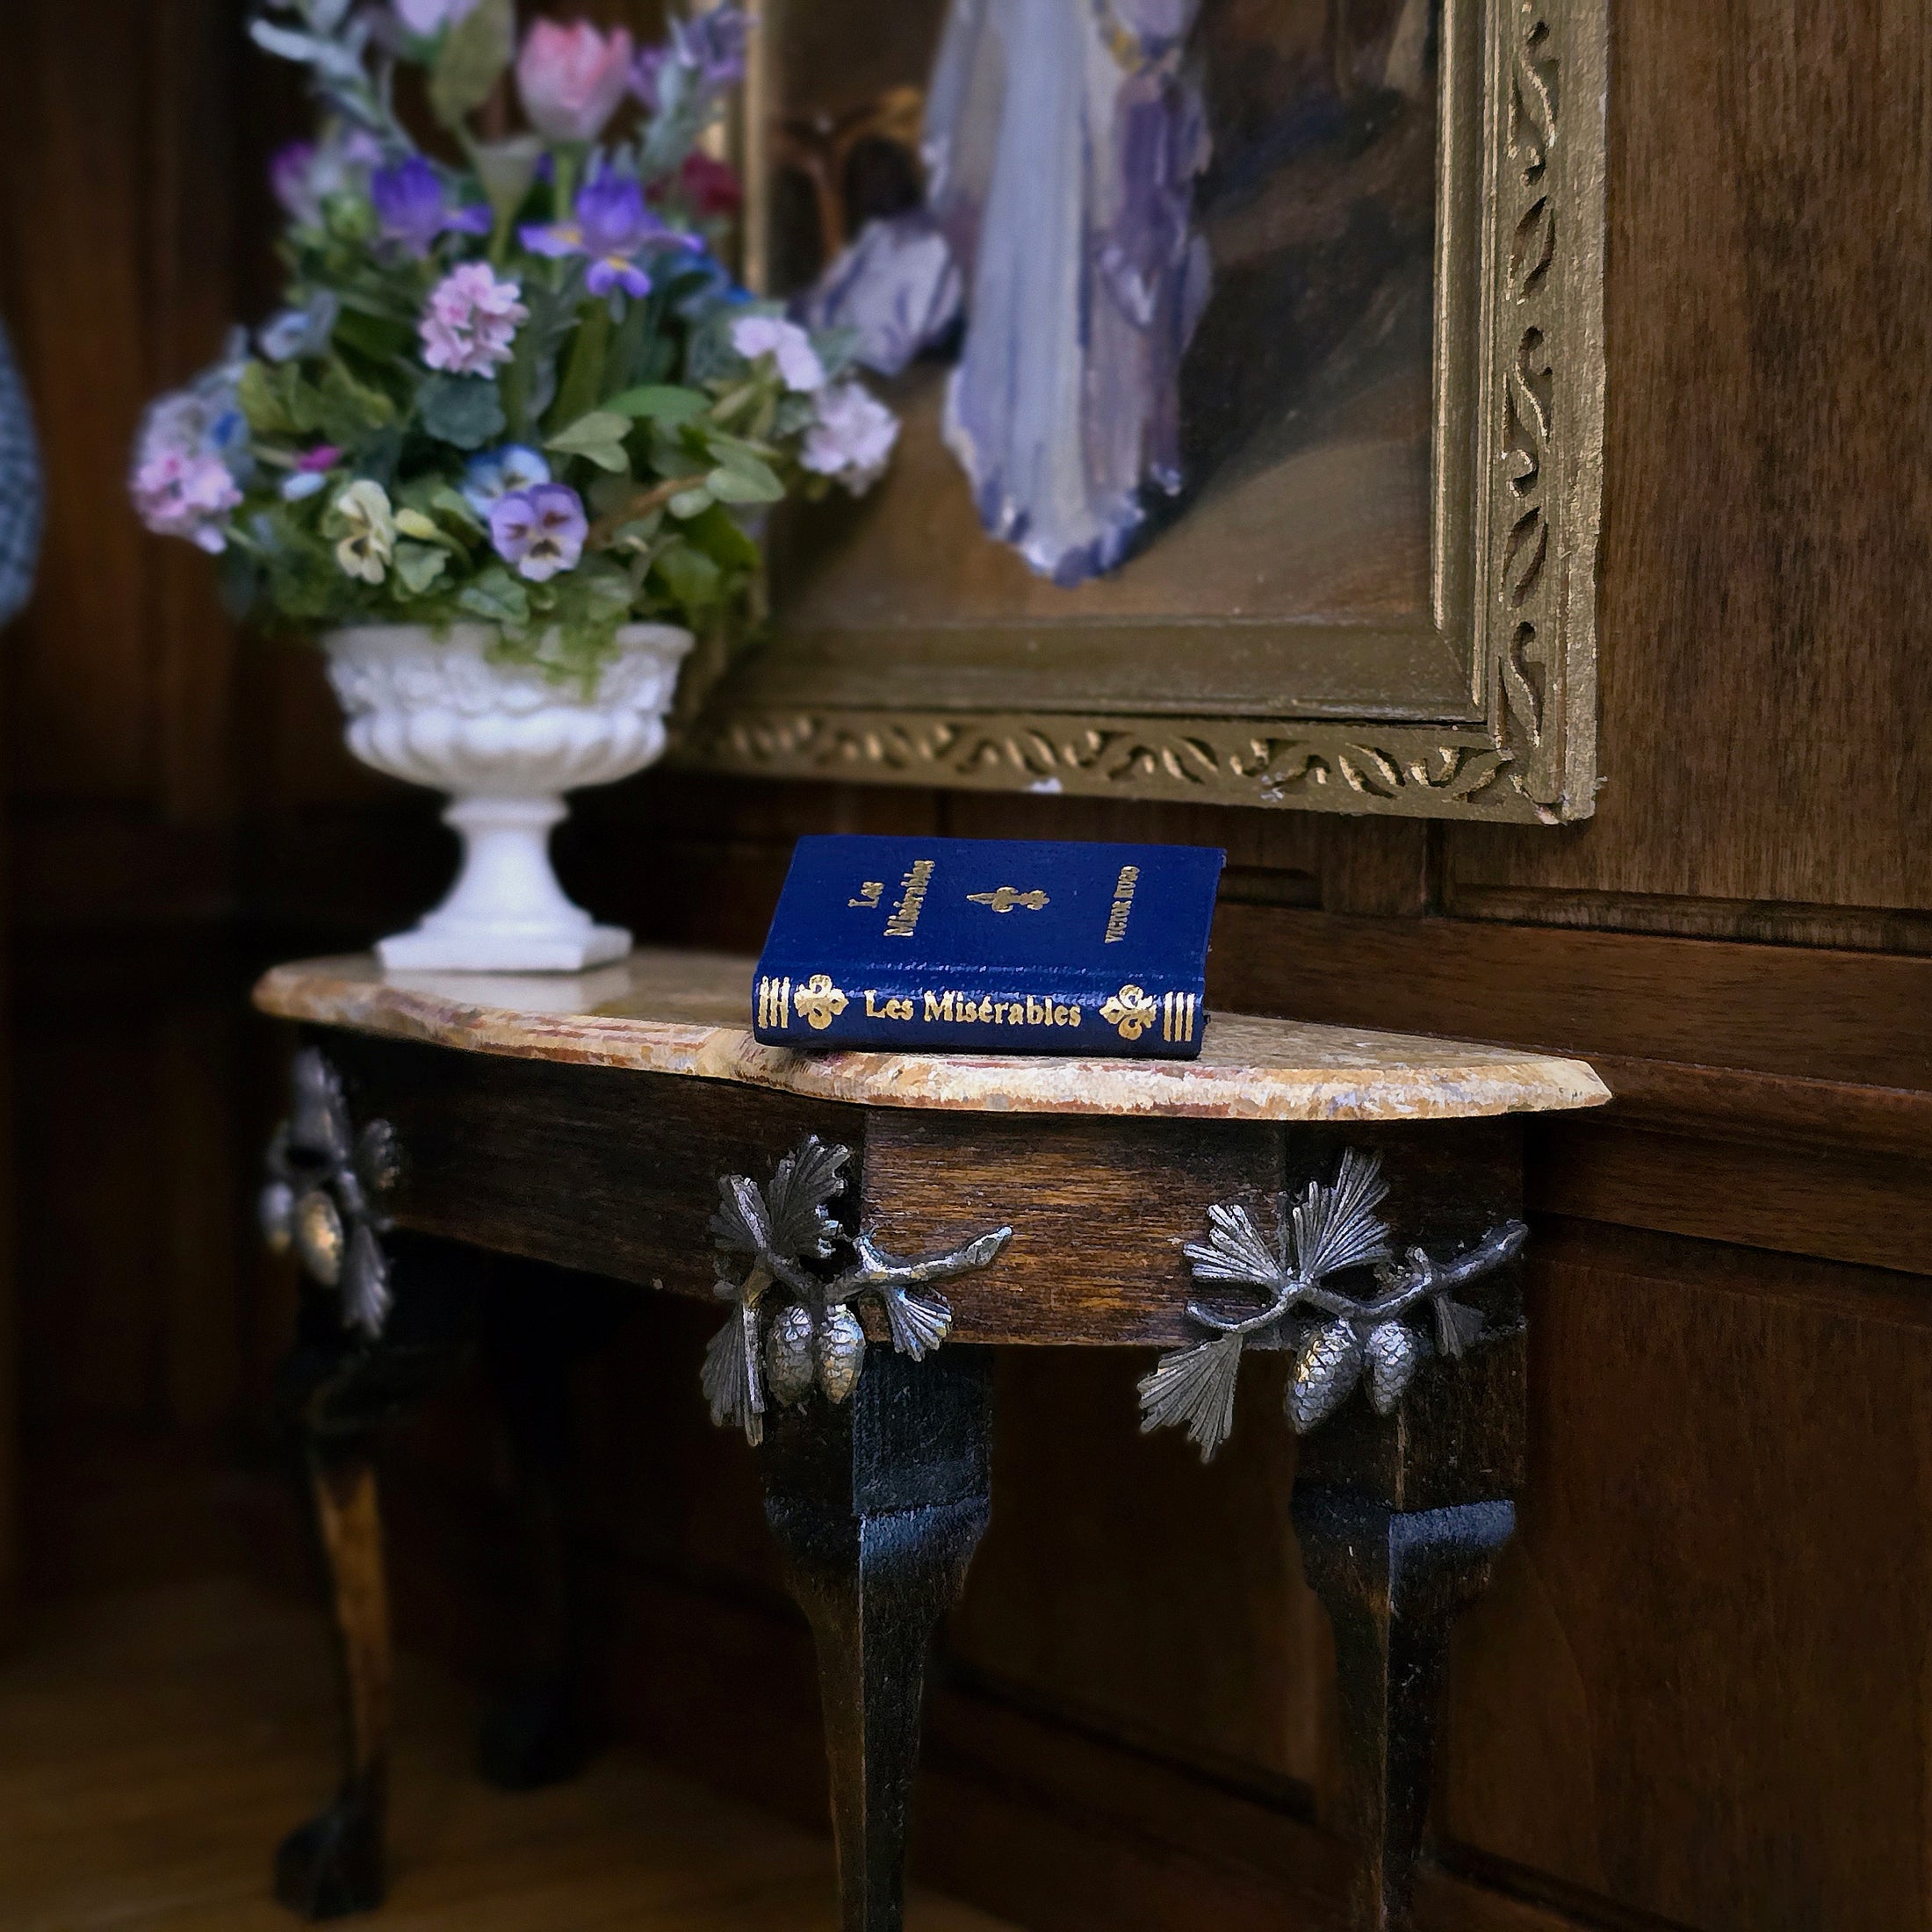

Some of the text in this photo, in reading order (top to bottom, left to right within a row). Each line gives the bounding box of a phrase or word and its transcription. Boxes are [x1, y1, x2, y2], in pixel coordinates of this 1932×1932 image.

[847, 881, 884, 908] Les
[1104, 865, 1140, 944] VICTOR HUGO
[863, 989, 1082, 1027] Les Misérables
